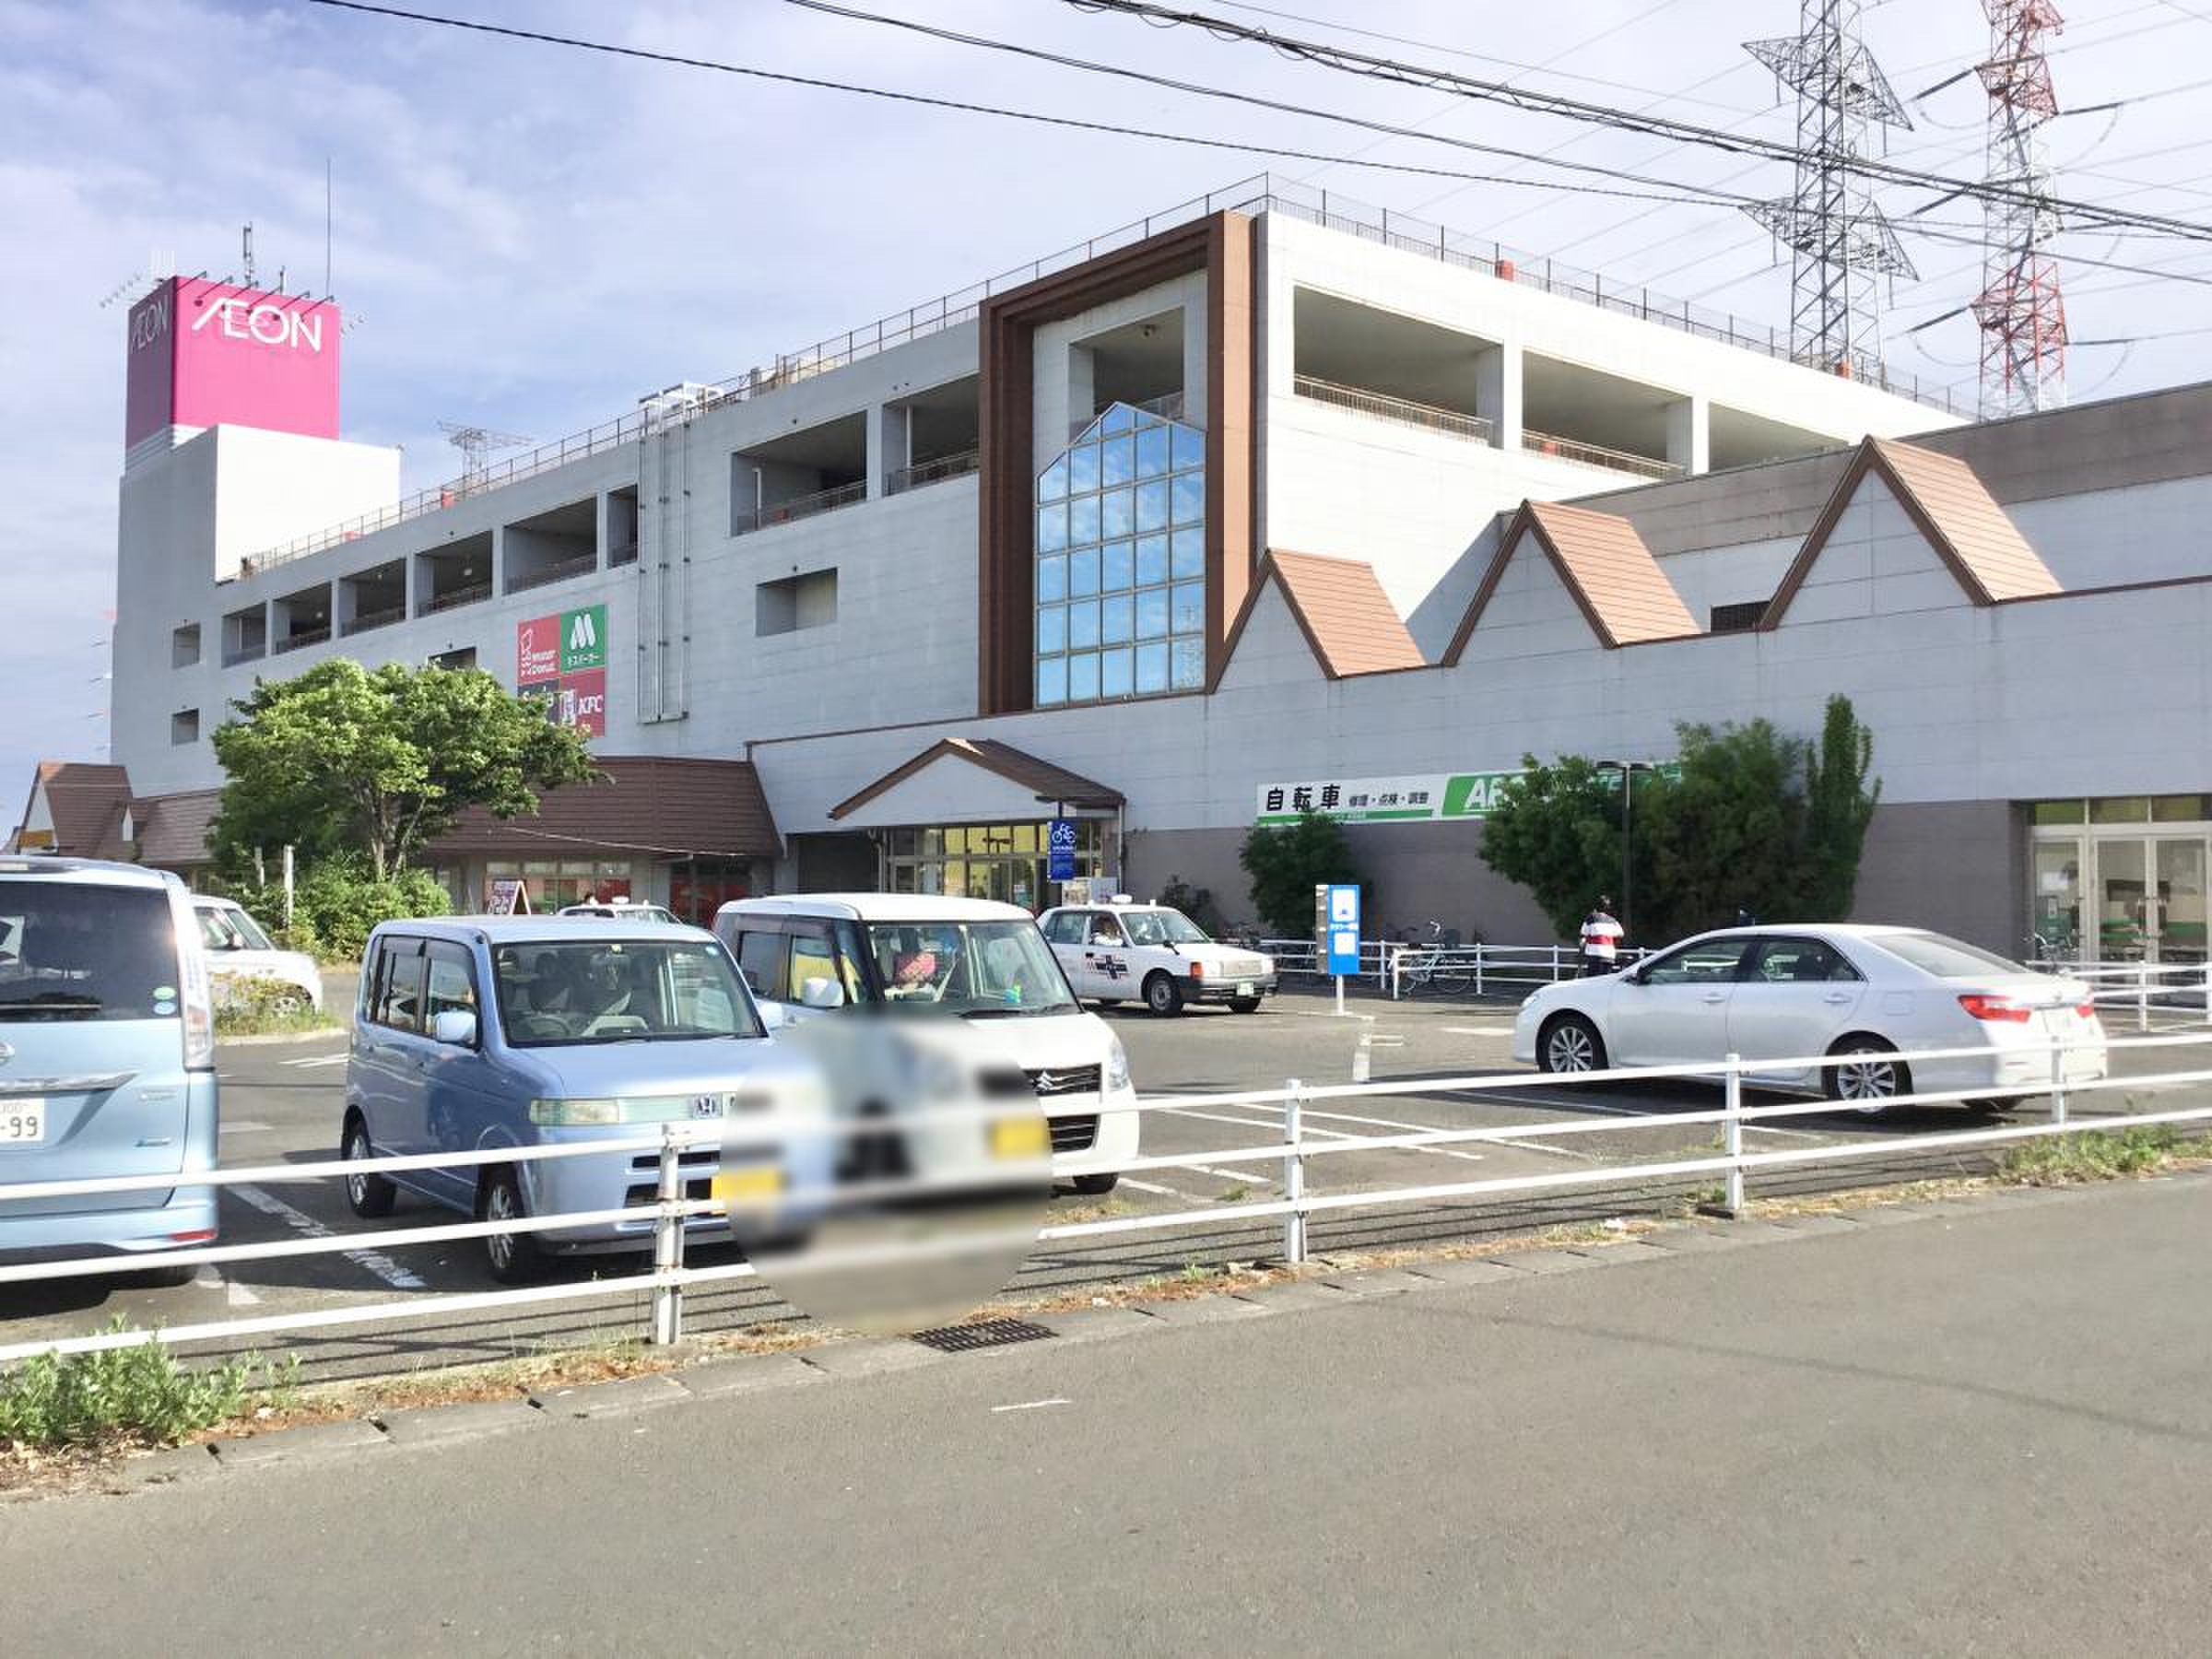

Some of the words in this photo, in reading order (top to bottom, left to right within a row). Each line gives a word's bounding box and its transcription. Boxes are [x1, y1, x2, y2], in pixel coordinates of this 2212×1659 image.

[578, 694, 604, 715] KFC
[1266, 783, 1341, 811] 自転車
